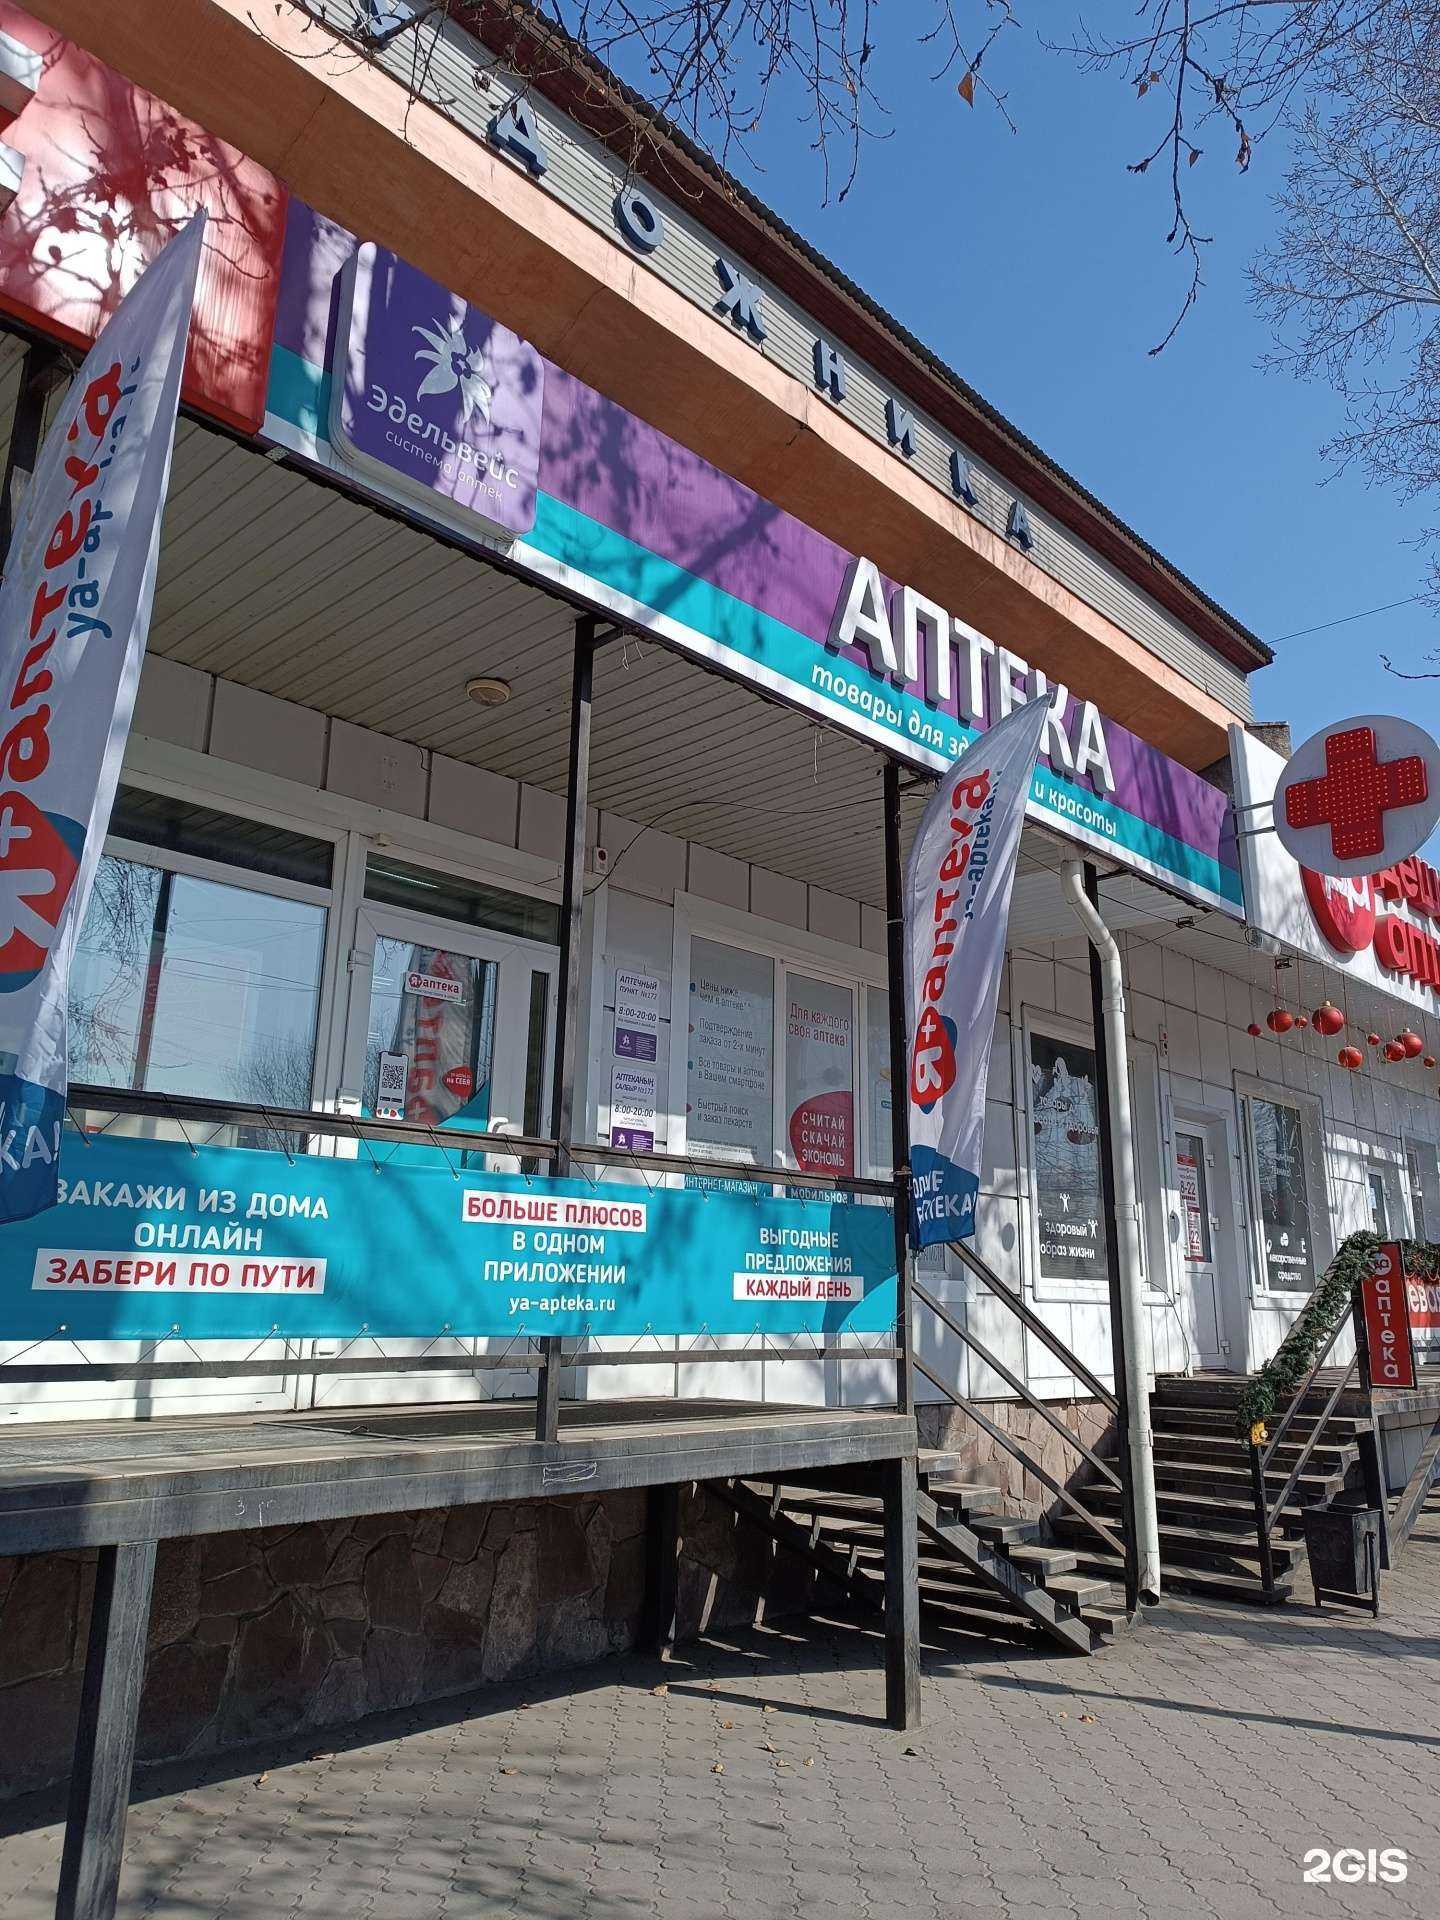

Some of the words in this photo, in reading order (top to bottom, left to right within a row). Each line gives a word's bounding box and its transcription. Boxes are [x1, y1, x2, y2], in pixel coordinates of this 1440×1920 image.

[366, 384, 519, 489] Эдельвейс
[386, 430, 452, 474] система
[458, 471, 503, 501] аптек
[830, 556, 1115, 793] АПТЕКА
[810, 662, 902, 728] товары
[908, 711, 944, 753] для
[1034, 781, 1044, 799] и
[1049, 790, 1117, 837] красоты
[423, 979, 459, 993] аптека
[620, 975, 657, 990] АПТЕЧНЫЙ
[620, 985, 638, 995] ПУНКТ
[618, 1006, 656, 1022] 8:00-20:00
[790, 1003, 808, 1020] Для
[812, 1010, 848, 1030] каждого
[789, 1023, 810, 1039] своя
[615, 1104, 653, 1117] 8:00-20:00
[801, 1111, 845, 1130] СЧИТАЙ
[801, 1130, 845, 1148] СКАЧАЙ
[801, 1149, 845, 1167] ЭКОНОМЬ
[199, 1188, 236, 1214] ИЗ
[246, 1192, 329, 1220] ДОМА
[468, 1197, 558, 1222] БОЛЬШЕ
[565, 1203, 643, 1228] ПЛЮСОВ
[134, 1220, 263, 1252] ОНЛАЙН
[760, 1227, 839, 1250] ВЫГОДНЫЕ
[1045, 1221, 1088, 1237] здоровый
[513, 1231, 526, 1252] В
[533, 1232, 605, 1256] ОДНОМ
[1040, 1241, 1067, 1258] образ
[1069, 1245, 1095, 1259] жизни
[46, 1258, 176, 1286] ЗАБЕРИ
[188, 1262, 230, 1287] ПО
[241, 1264, 316, 1289] ПУТИ
[484, 1260, 626, 1285] ПРИЛОЖЕНИИ
[745, 1252, 852, 1274] ПРЕДЛОЖЕНИЯ
[746, 1276, 812, 1298] КАЖДЫЙ
[816, 1280, 852, 1299] ДЕНЬ
[509, 1295, 616, 1315] ya-apteka.ru
[1375, 1279, 1399, 1378] аптека
